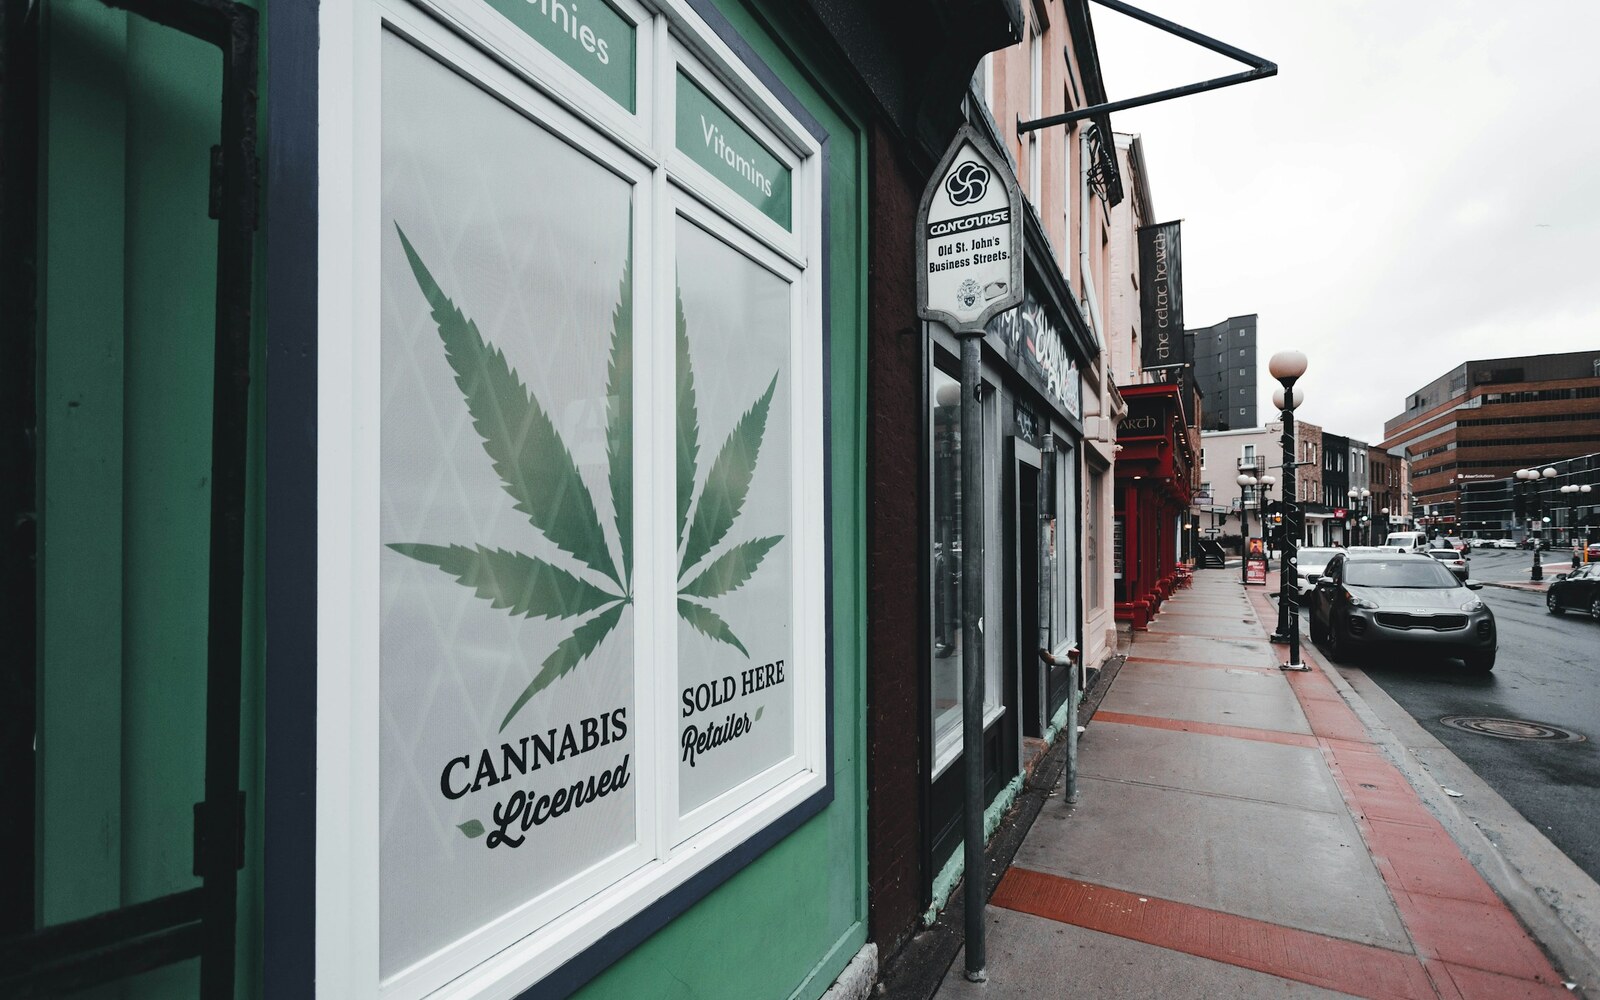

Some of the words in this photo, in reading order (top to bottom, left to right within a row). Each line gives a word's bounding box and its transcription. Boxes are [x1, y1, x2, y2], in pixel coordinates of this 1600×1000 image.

[700, 114, 772, 198] Vitamins
[930, 210, 1009, 236] CONCOURSE
[937, 244, 953, 257] Old
[955, 242, 968, 254] St.
[971, 236, 1000, 251] John's
[929, 258, 971, 274] Business
[973, 250, 1010, 265] Streets.
[440, 706, 628, 801] CANNABIS
[681, 675, 737, 718] SOLD
[741, 659, 785, 697] HERE
[485, 753, 631, 850] Licensed
[681, 711, 753, 768] Retailer
